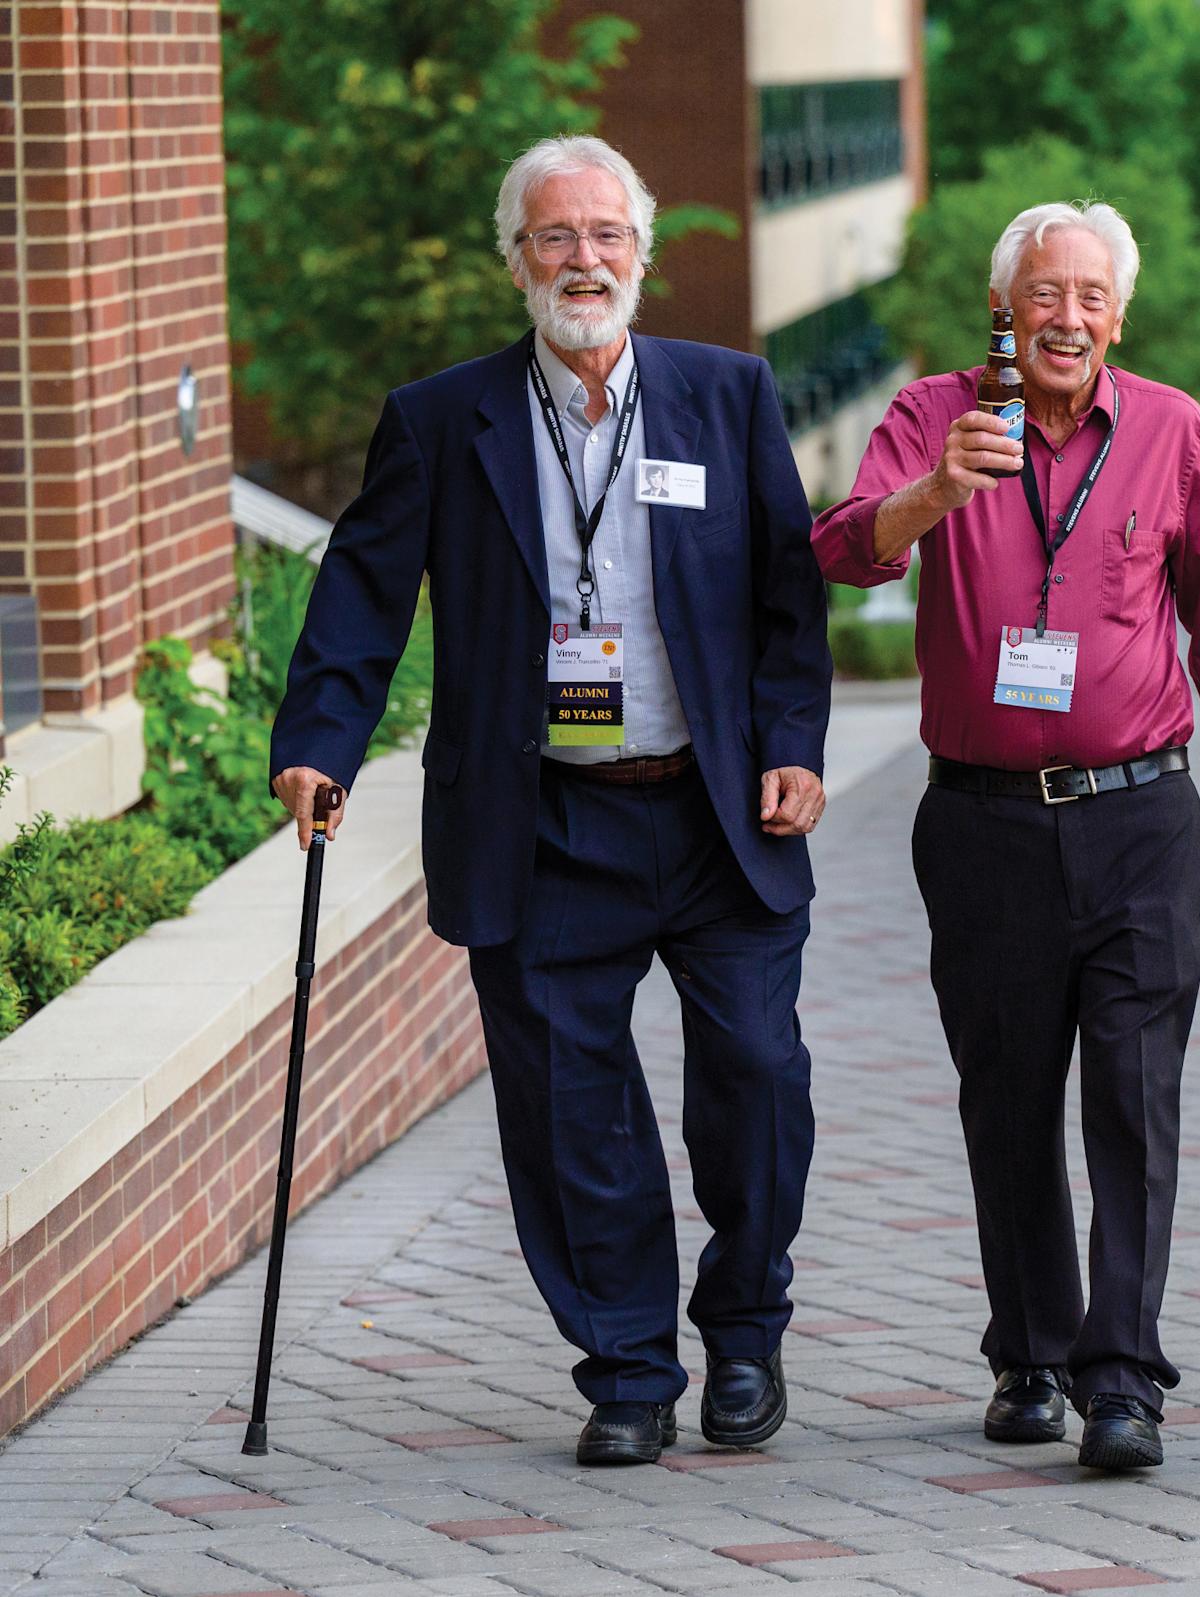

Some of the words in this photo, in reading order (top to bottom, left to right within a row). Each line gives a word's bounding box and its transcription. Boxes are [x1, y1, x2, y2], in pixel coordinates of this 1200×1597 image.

[628, 382, 637, 404] ALUMNI
[546, 406, 557, 427] ALUMNI
[621, 412, 631, 436] STEVENS
[553, 427, 565, 453] STEVENS
[616, 435, 626, 458] ALUMNI
[1088, 458, 1102, 482] STEVENS
[1099, 439, 1112, 460] ALUMNI
[1065, 507, 1079, 532] STEVENS
[1075, 488, 1089, 509] ALUMNI
[556, 649, 581, 659] Vinny
[1008, 651, 1028, 661] Tom
[560, 688, 609, 698] ALUMNI
[1005, 690, 1018, 699] 55
[1020, 691, 1060, 704] YEARS
[559, 710, 570, 719] 50
[573, 710, 612, 720] YEARS
